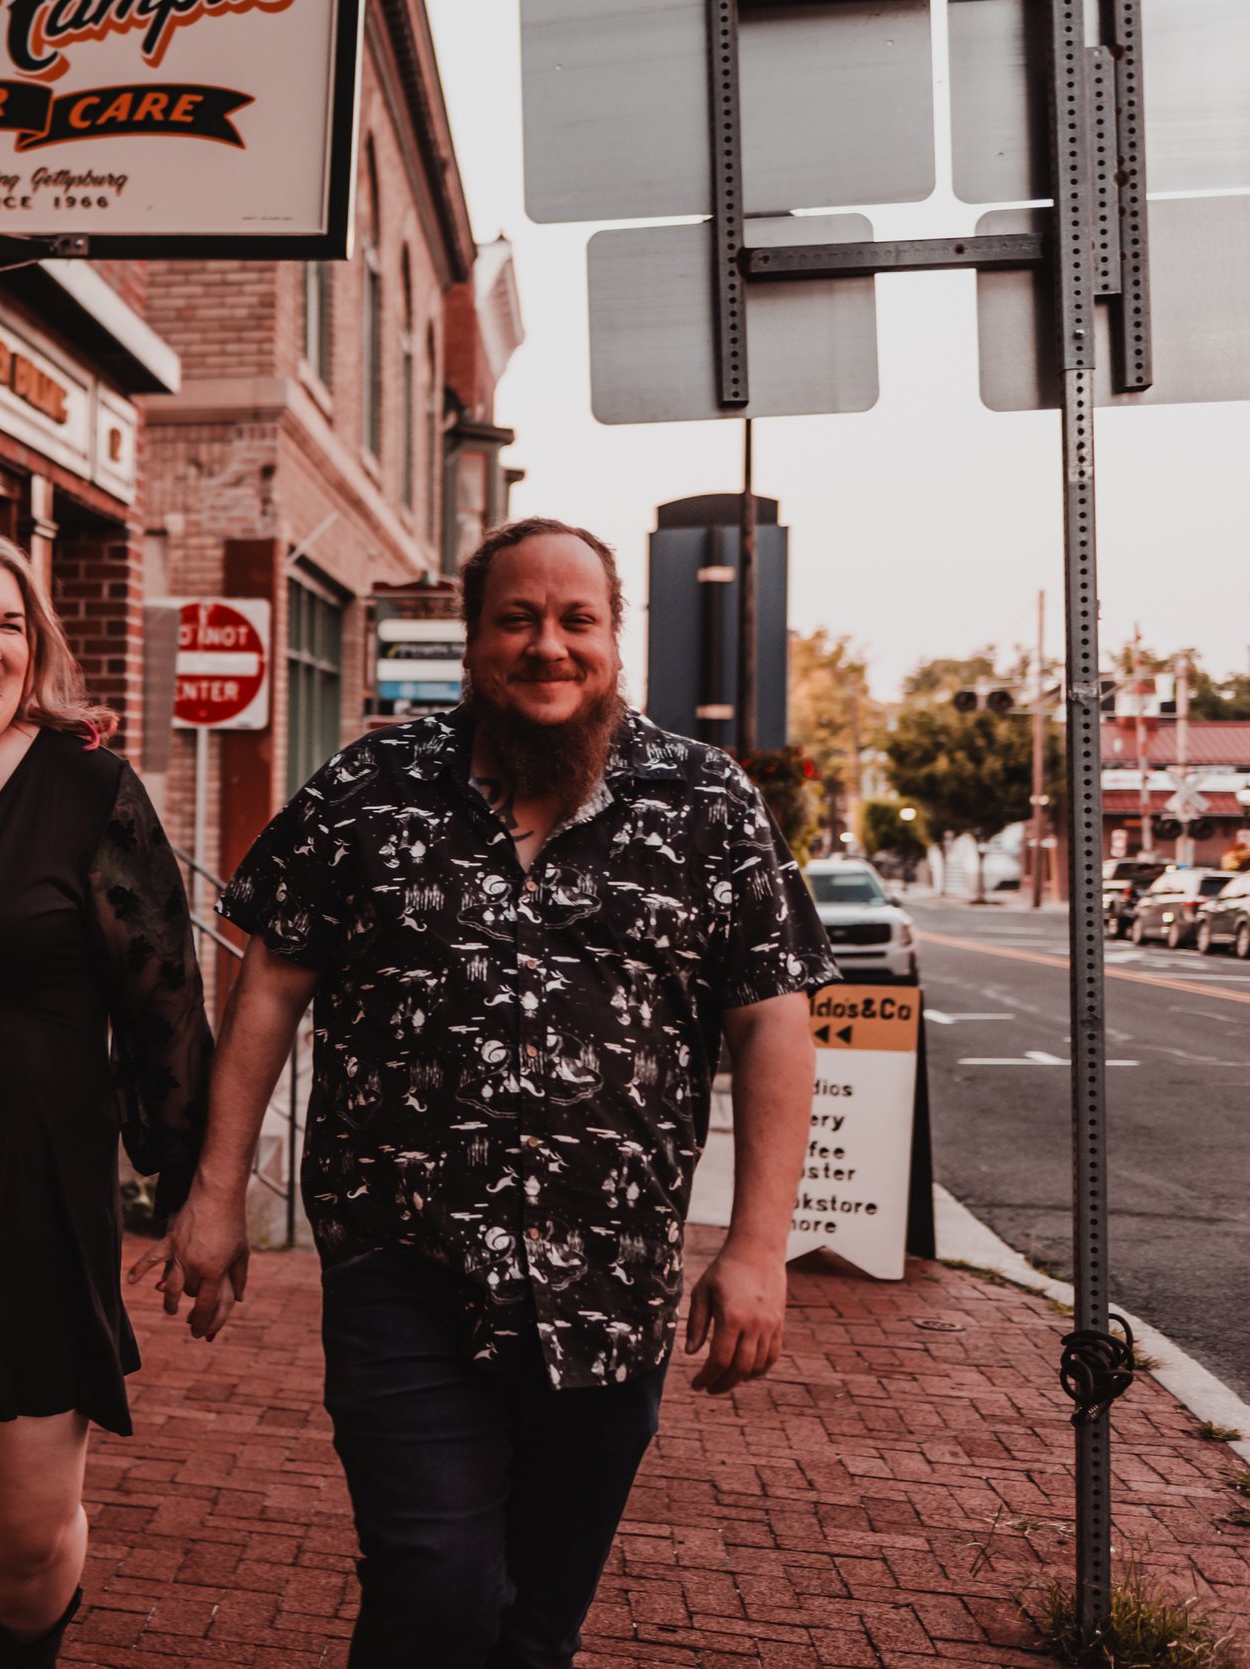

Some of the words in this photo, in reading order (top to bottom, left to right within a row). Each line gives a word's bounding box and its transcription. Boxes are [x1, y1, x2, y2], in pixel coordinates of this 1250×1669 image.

[68, 92, 204, 130] CARE
[30, 166, 130, 197] Gettysburg
[53, 196, 110, 209] 1966
[204, 625, 249, 648] NOT
